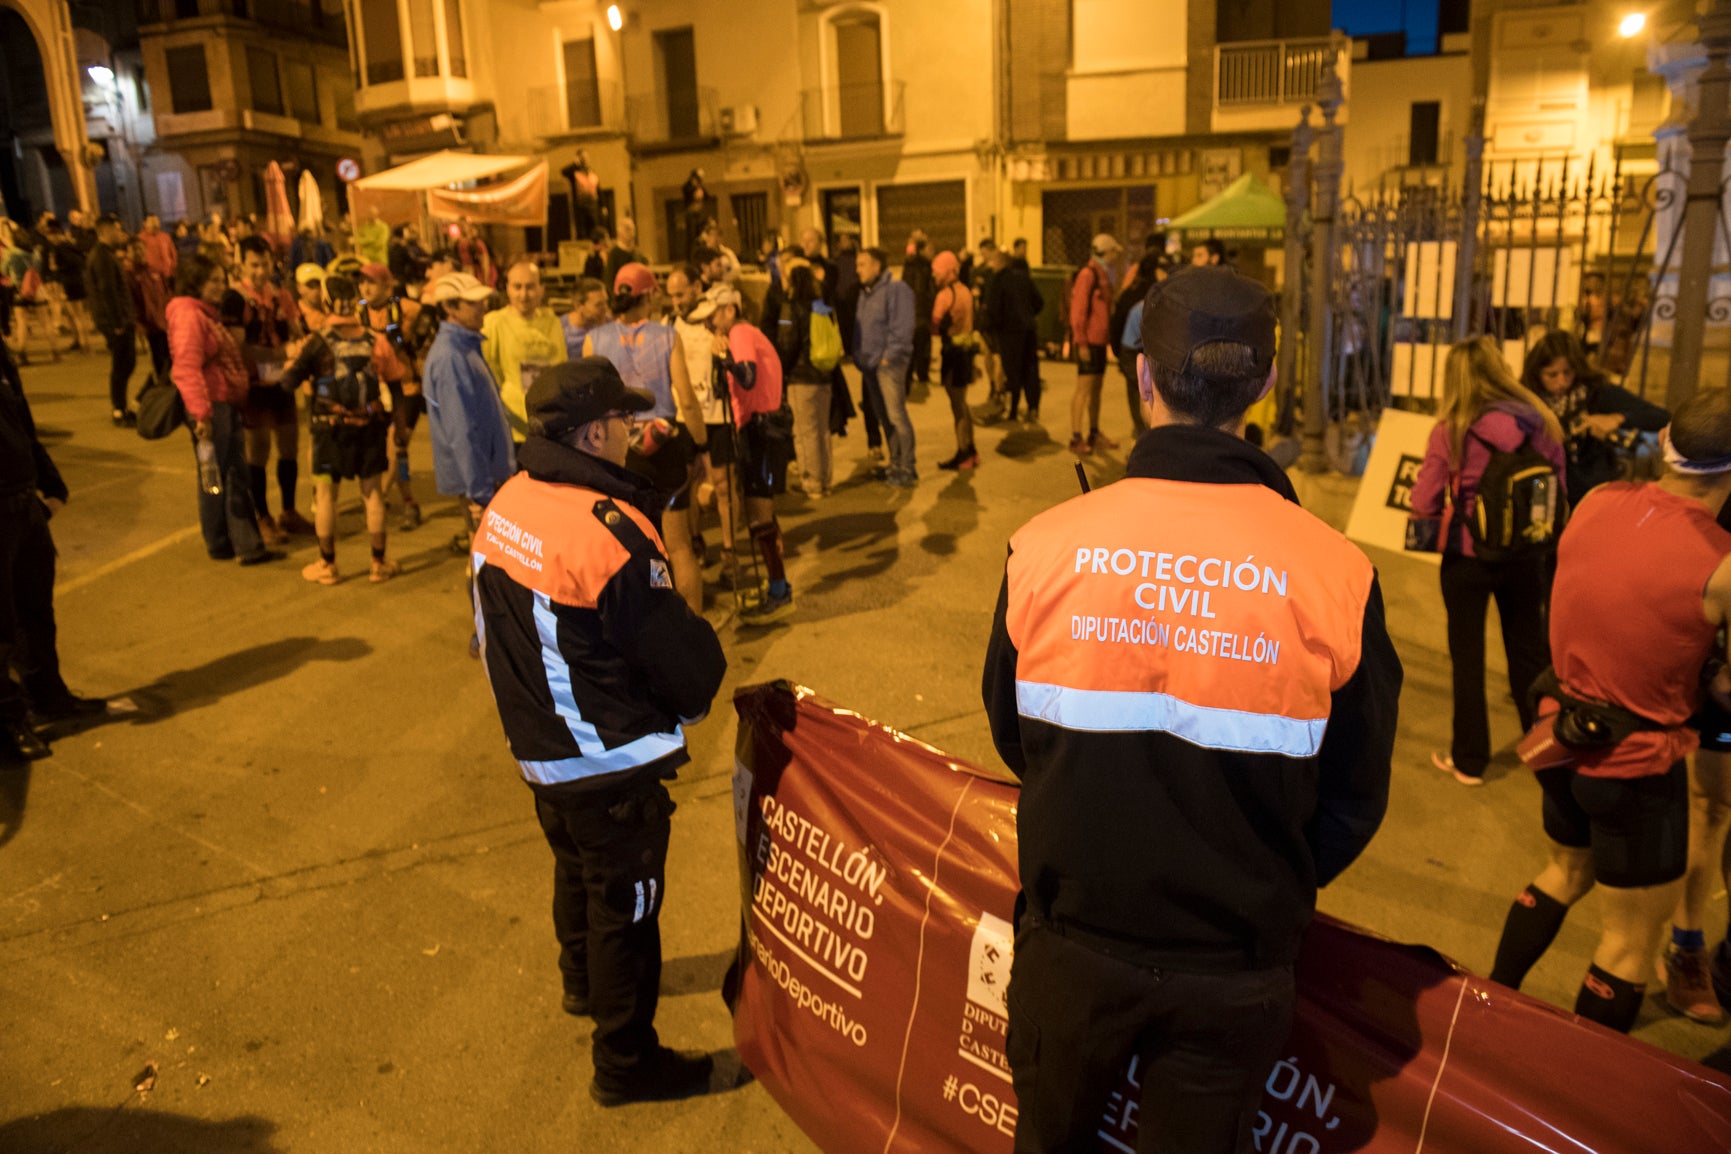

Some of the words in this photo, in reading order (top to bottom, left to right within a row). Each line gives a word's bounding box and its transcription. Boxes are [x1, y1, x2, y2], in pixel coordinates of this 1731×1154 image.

[520, 531, 543, 558] CIVIL
[1074, 547, 1288, 597] PROTECCIÓN
[1134, 582, 1217, 619] CIVIL
[1071, 615, 1170, 648] DIPUTACIÓN
[1173, 625, 1280, 665] CASTELLÓN
[762, 794, 887, 906] CASTELLÓN,
[756, 832, 875, 939] ESCENARIO
[753, 872, 868, 982] DEPORTIVO
[963, 1001, 1009, 1037] DIPUT
[942, 1074, 1020, 1138] #CSE
